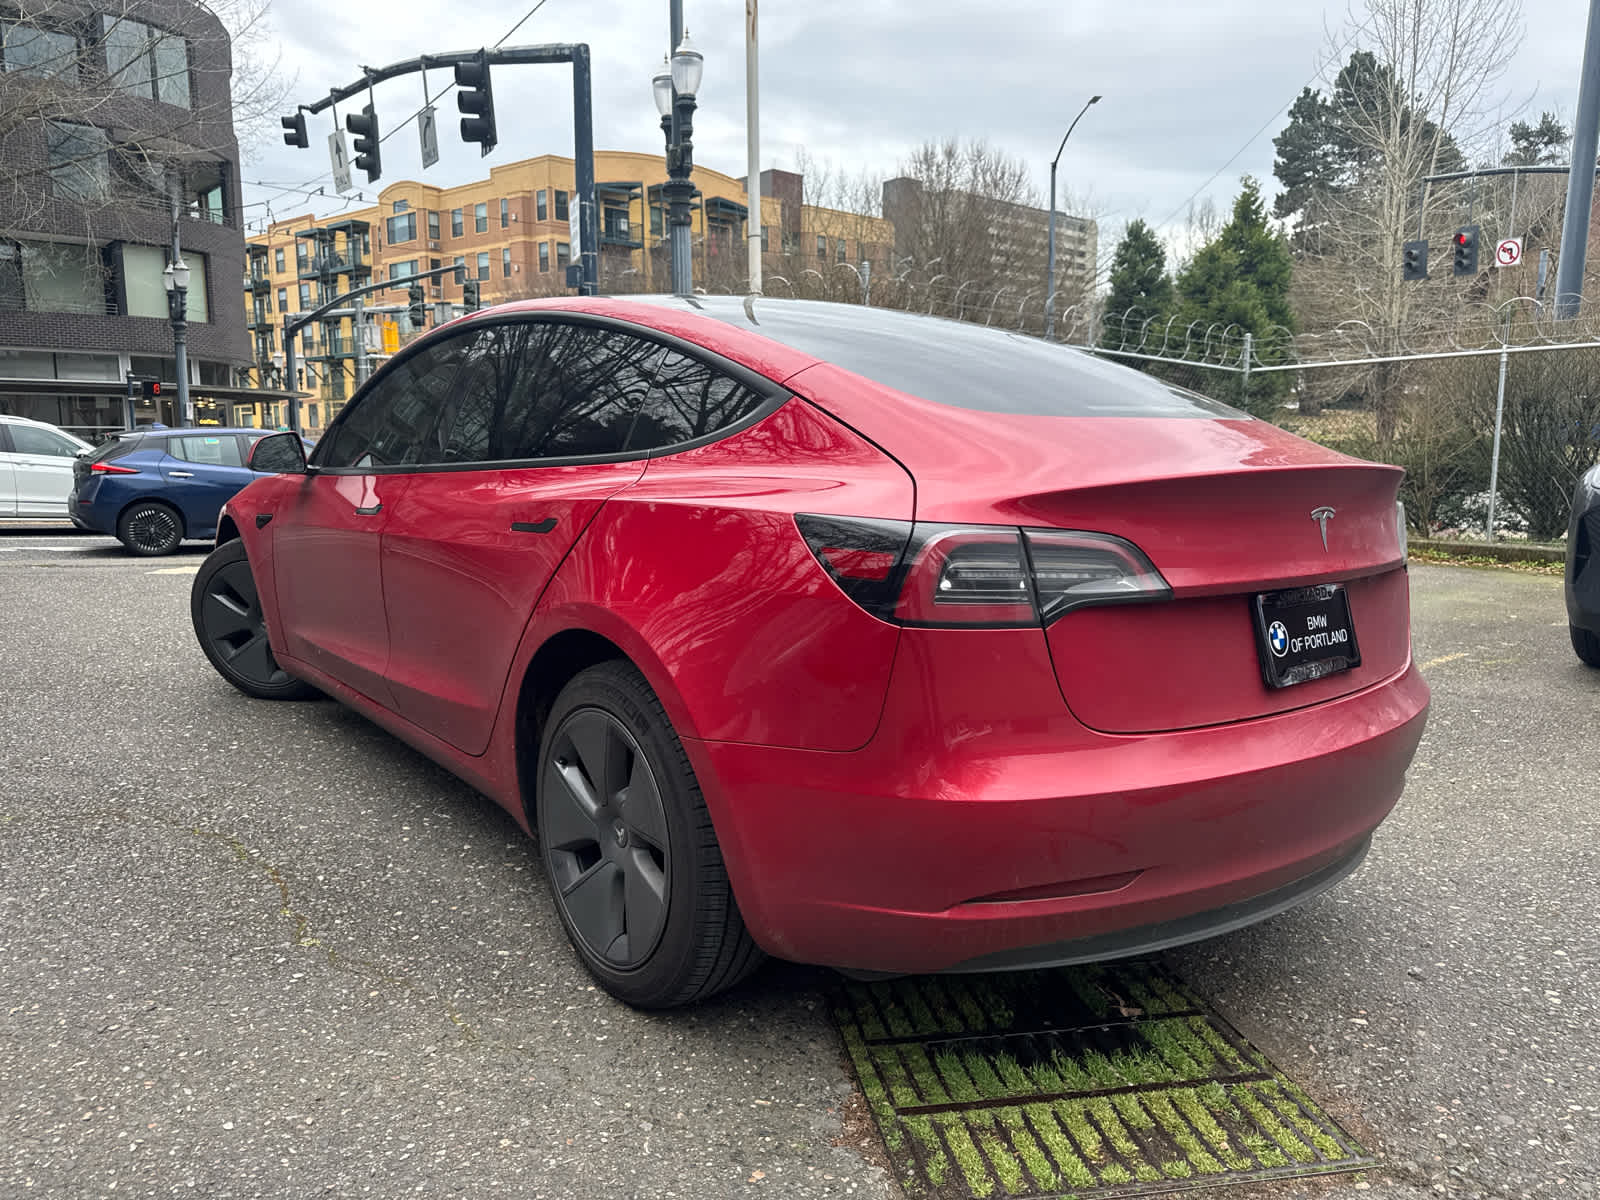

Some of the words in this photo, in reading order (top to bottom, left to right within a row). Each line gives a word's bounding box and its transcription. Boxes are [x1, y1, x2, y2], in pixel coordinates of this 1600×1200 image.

[1306, 614, 1327, 630] BMW
[1291, 638, 1303, 653] OF
[1304, 628, 1348, 650] PORTLAND
